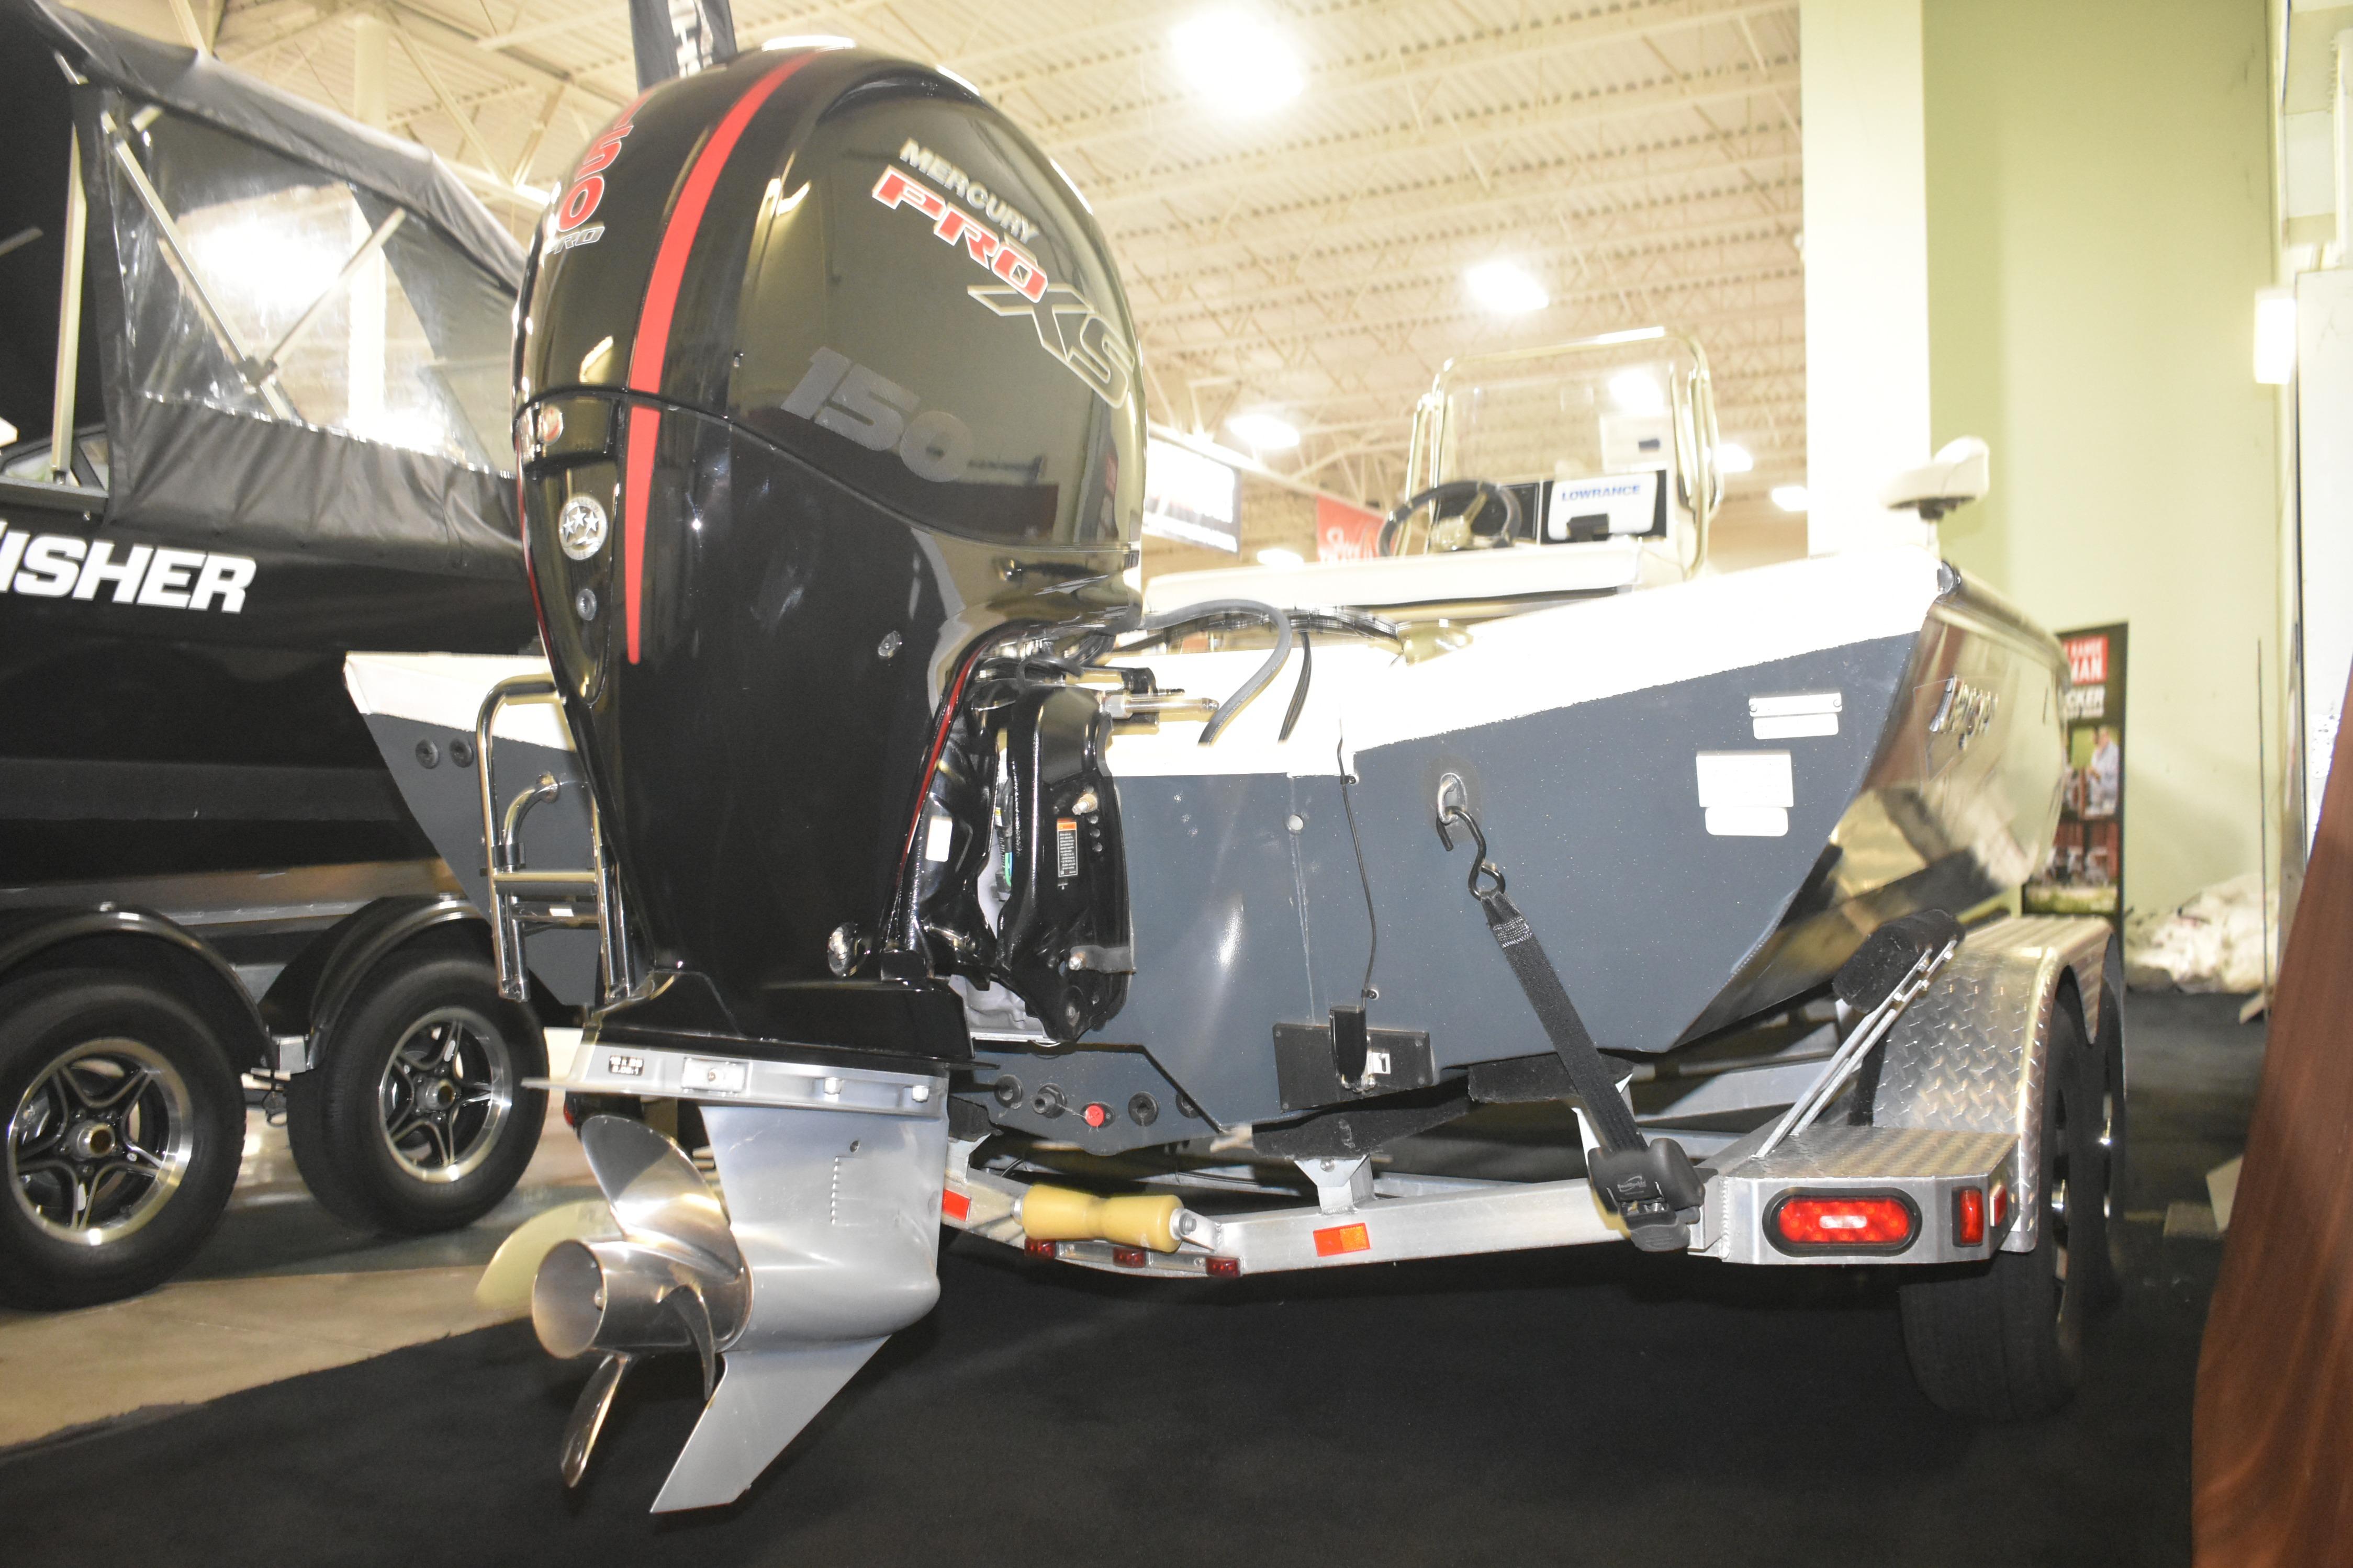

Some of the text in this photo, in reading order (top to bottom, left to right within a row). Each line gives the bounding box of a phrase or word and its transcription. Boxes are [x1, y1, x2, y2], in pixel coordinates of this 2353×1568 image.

[547, 226, 606, 255] RO
[871, 164, 1048, 303] PRO
[899, 137, 1040, 245] MERCURY
[967, 283, 1136, 409] XS
[780, 346, 973, 483] 150
[1561, 483, 1641, 502] LOWRANCE
[0, 518, 256, 614] ISHER
